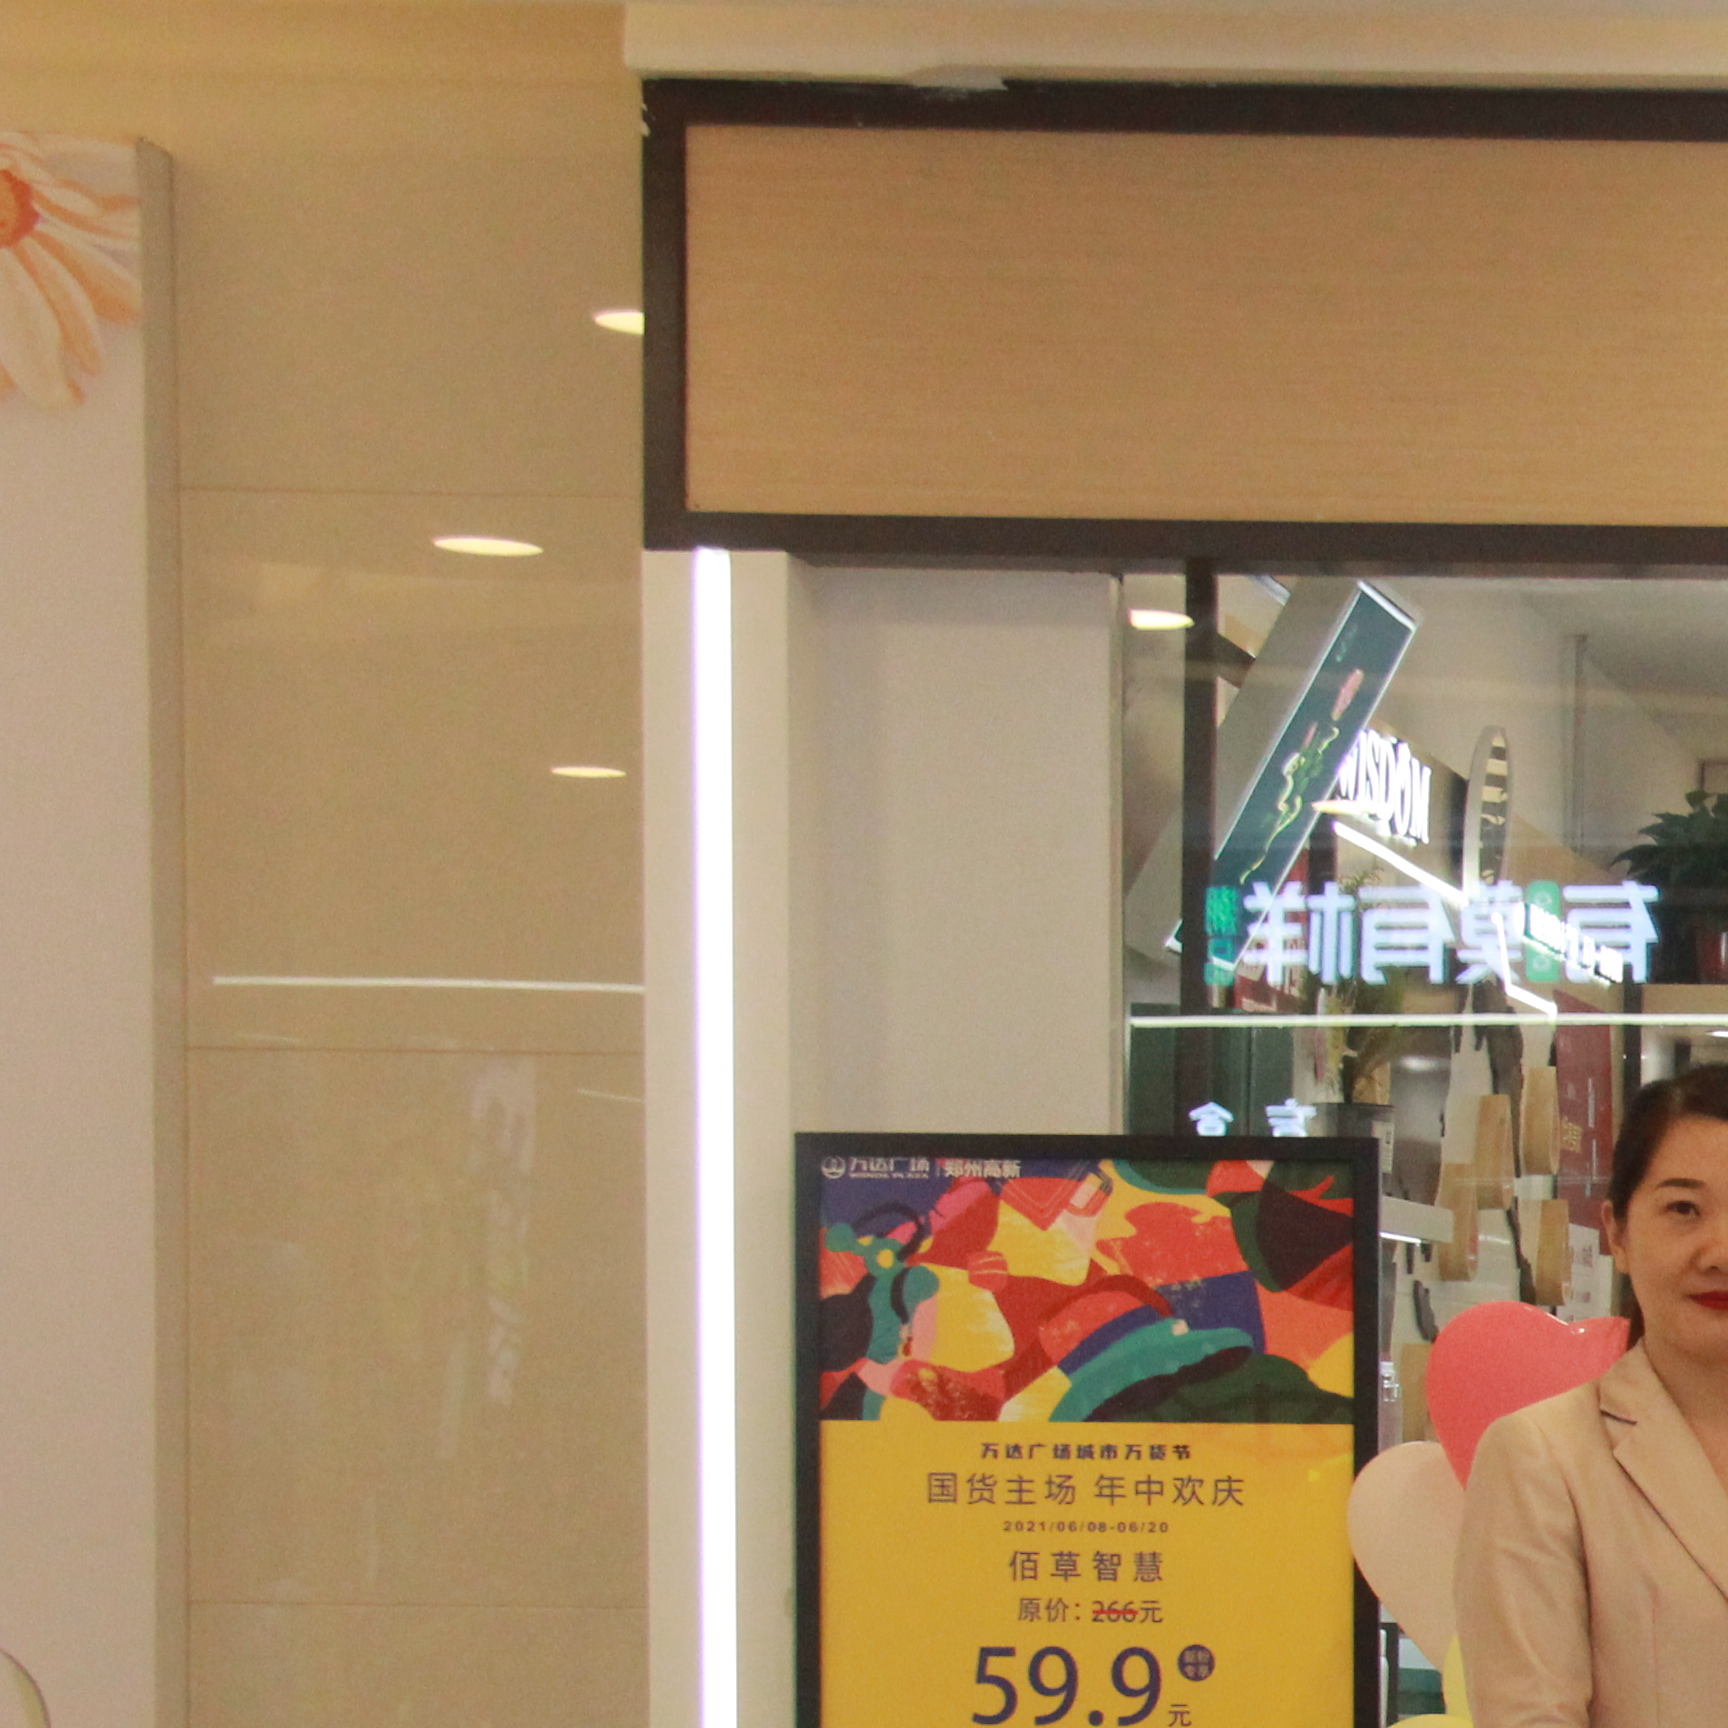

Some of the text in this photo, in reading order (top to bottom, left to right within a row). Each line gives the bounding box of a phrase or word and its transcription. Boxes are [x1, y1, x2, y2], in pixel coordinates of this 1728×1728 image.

[849, 1156, 931, 1172] 万达广场
[927, 1472, 1246, 1507] 国货主场 年中欢庆
[1003, 1520, 1169, 1533] 2021/06/08-06/20
[1009, 1550, 1164, 1583] 佰草智慧
[971, 1645, 1162, 1728] 59.9
